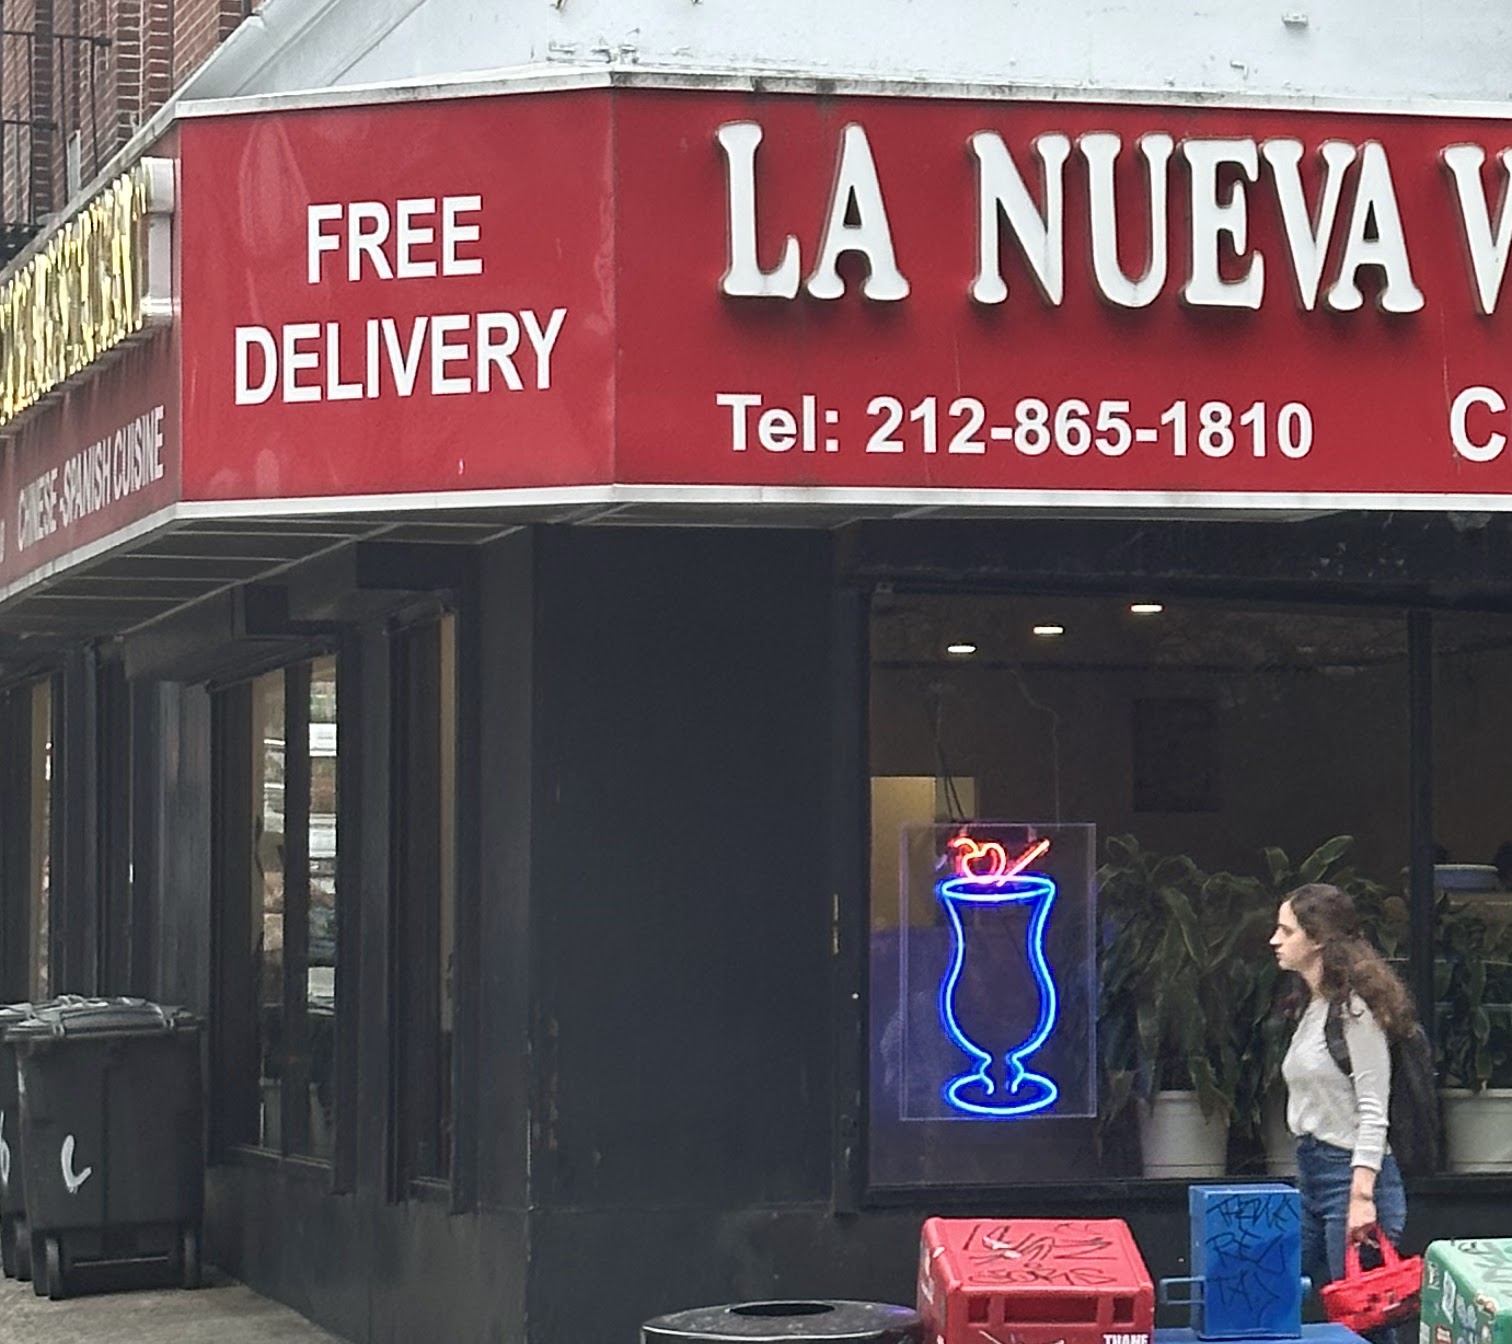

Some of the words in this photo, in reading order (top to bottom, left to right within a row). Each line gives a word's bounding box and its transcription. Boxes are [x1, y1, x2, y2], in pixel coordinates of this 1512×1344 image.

[307, 195, 483, 284] FREE
[715, 120, 911, 301] LA
[967, 130, 1425, 313] NUEVA
[234, 308, 567, 405] DELIVERY
[717, 393, 841, 453] Tel:
[866, 396, 1314, 458] 212-865-1810
